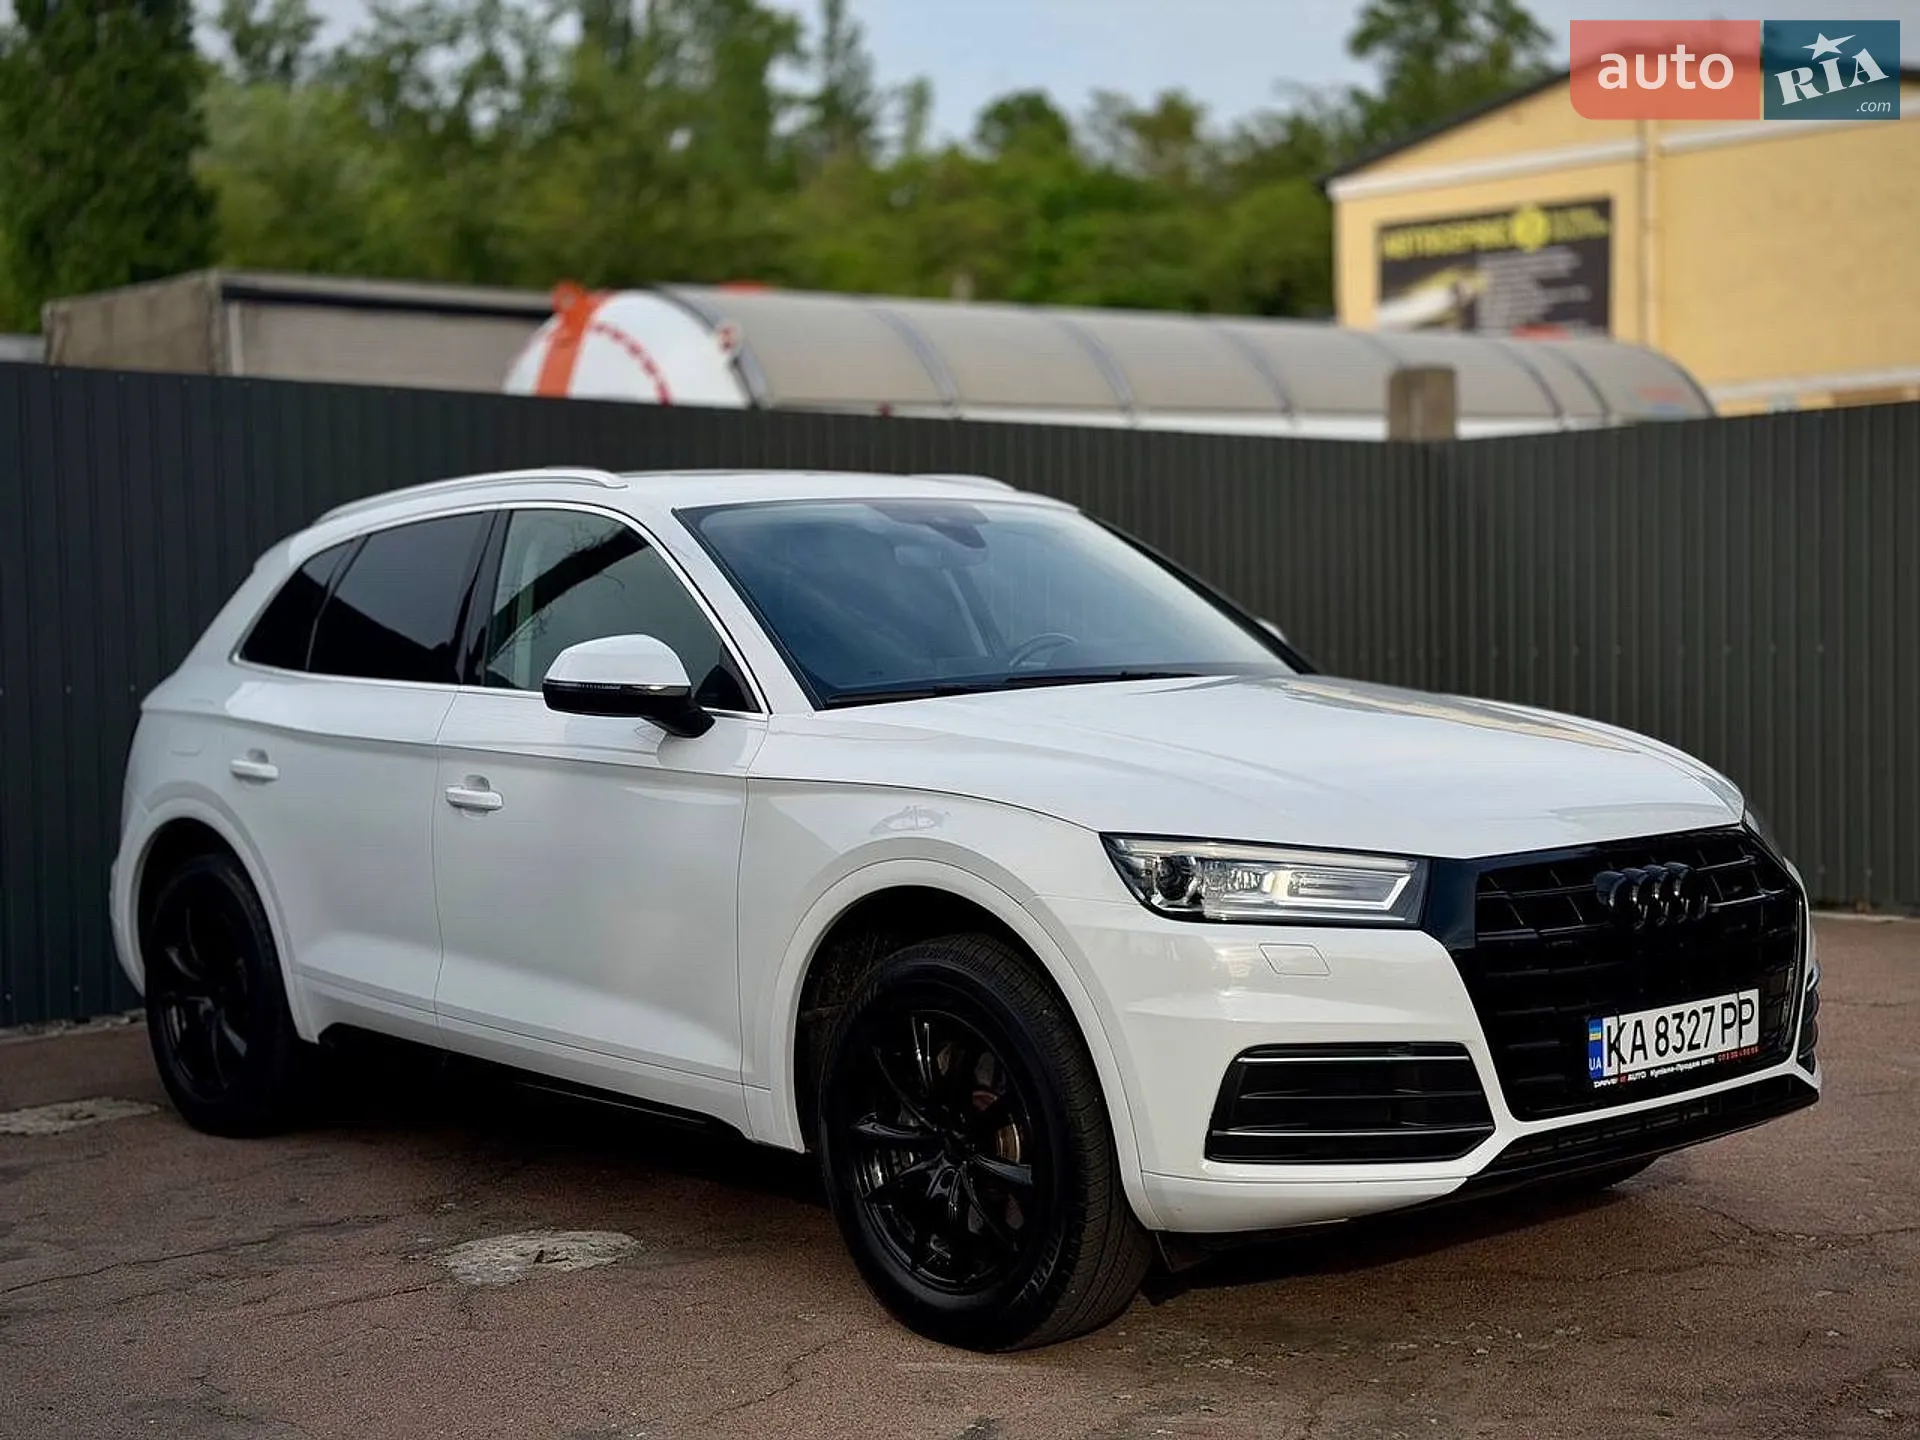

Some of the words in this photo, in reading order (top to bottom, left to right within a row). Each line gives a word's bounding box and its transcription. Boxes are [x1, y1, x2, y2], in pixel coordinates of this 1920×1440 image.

[1607, 1019, 1648, 1068] KA
[1655, 1004, 1715, 1057] 8327
[1720, 998, 1755, 1045] PP
[1588, 1056, 1602, 1071] UA
